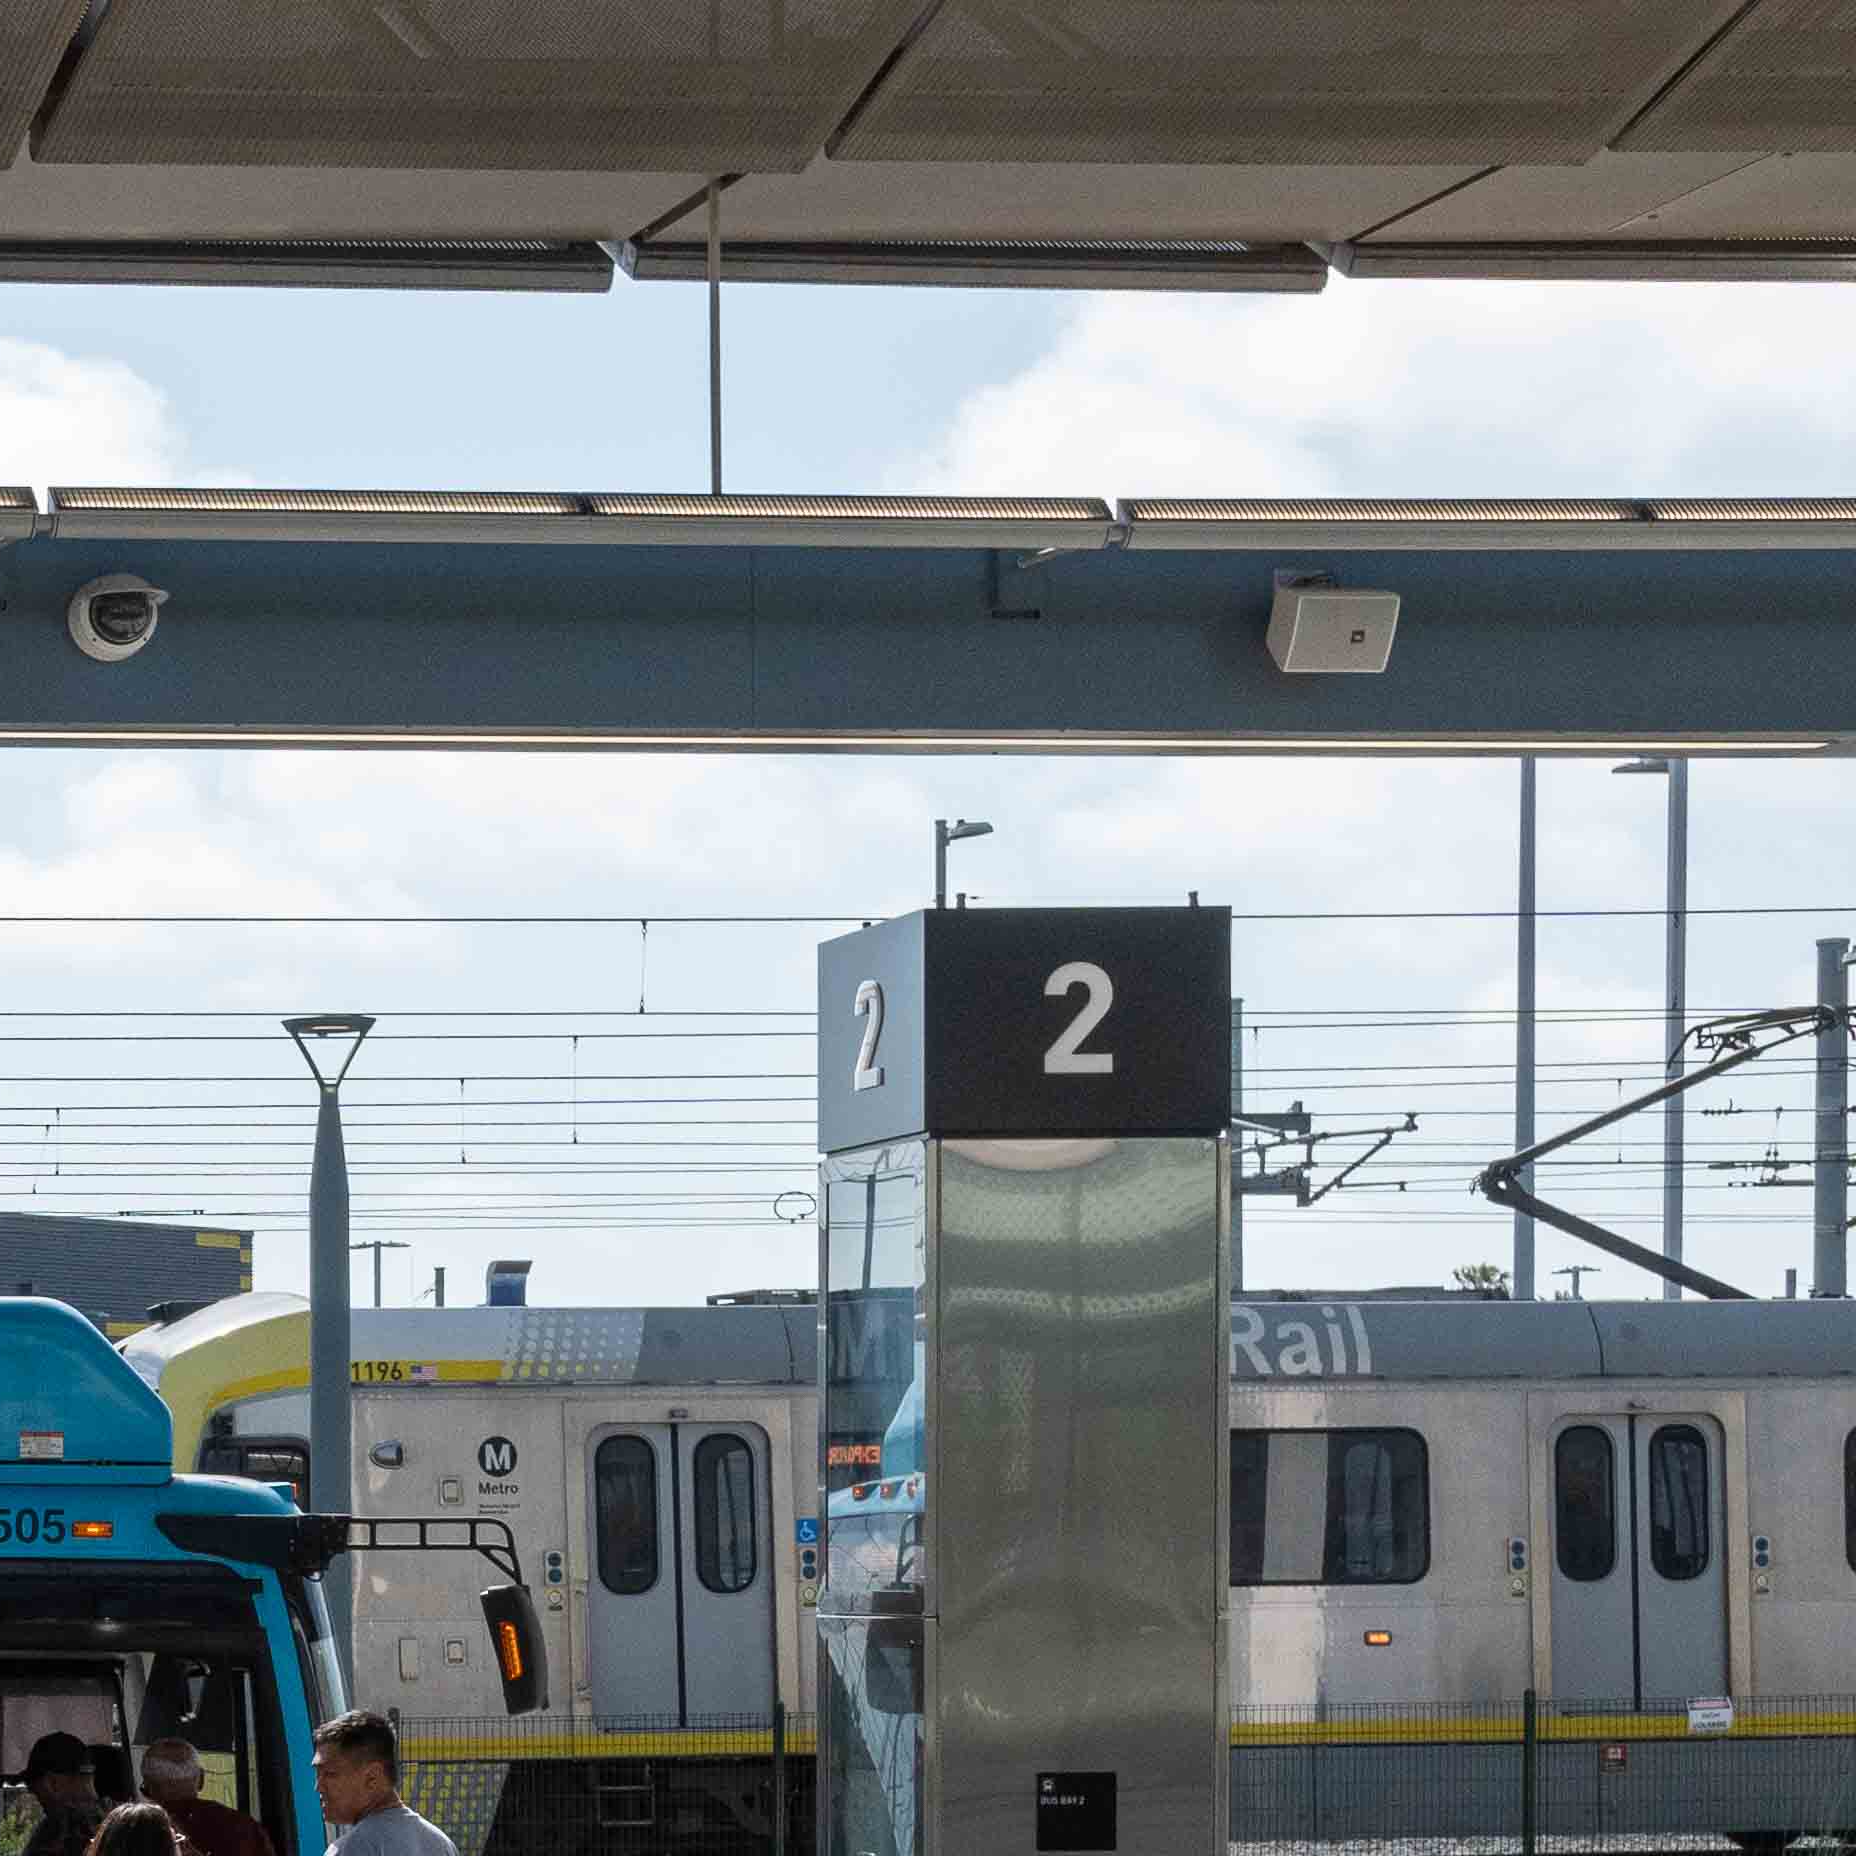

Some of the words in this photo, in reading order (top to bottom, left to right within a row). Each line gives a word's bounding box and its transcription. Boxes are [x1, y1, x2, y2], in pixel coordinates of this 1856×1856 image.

[854, 979, 884, 1092] 2
[1044, 961, 1113, 1073] 2
[1230, 1304, 1372, 1375] Rail
[478, 1482, 520, 1495] Metro
[484, 1443, 511, 1470] M
